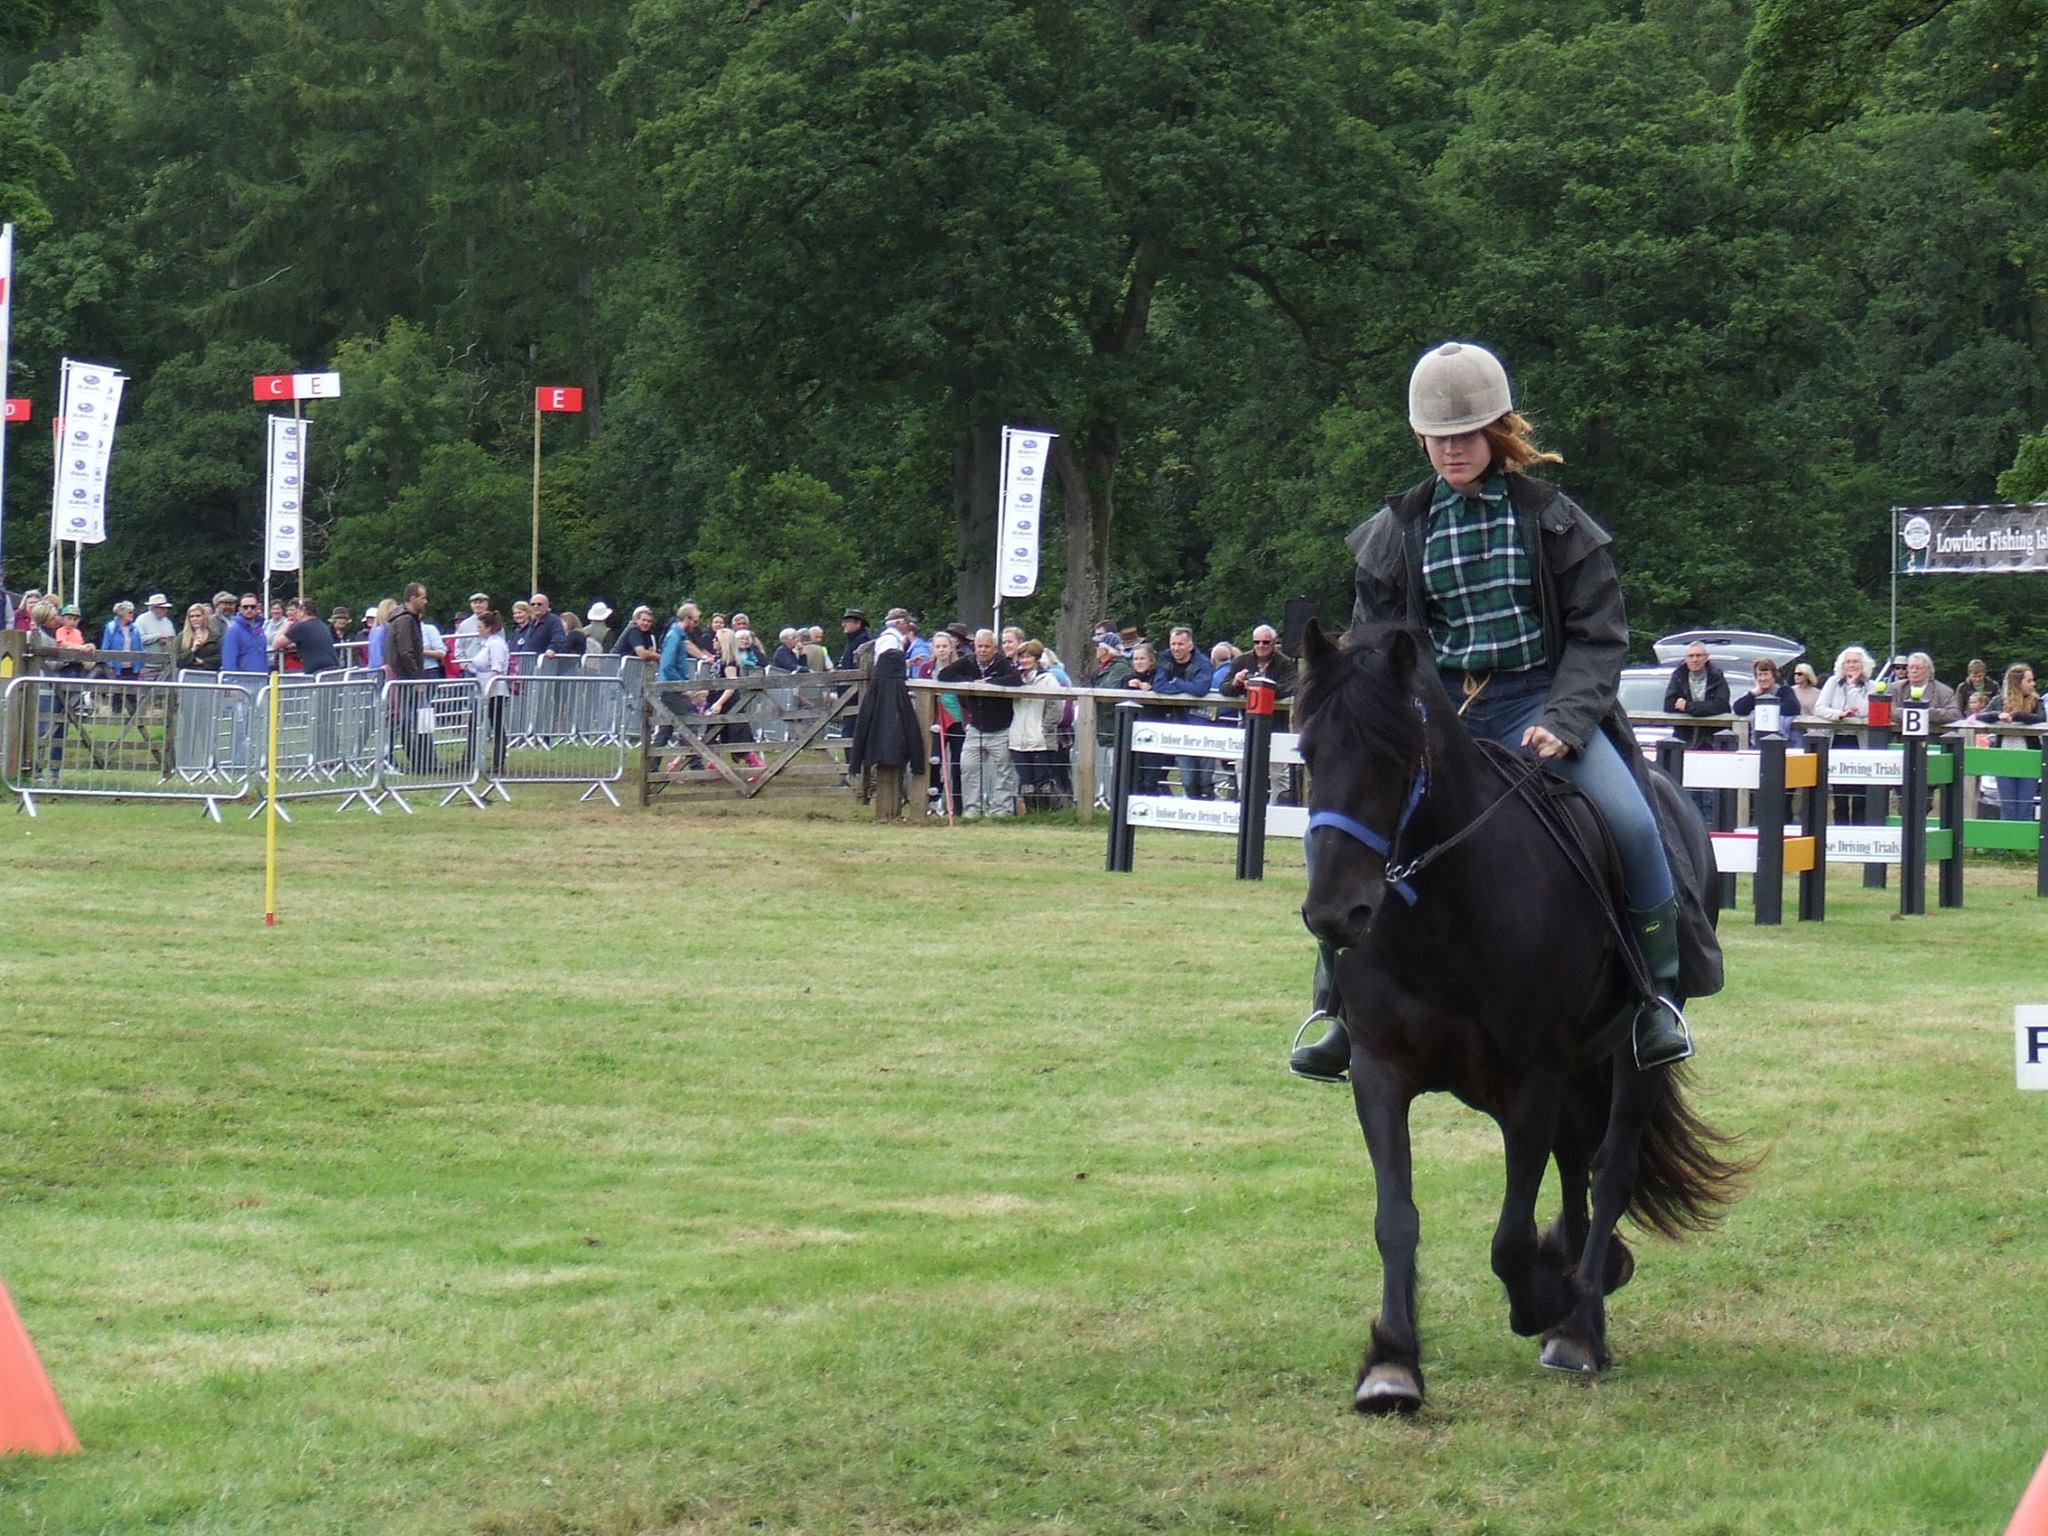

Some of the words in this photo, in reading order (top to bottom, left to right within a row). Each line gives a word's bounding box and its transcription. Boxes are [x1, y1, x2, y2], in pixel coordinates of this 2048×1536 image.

[270, 379, 282, 395] C
[311, 377, 322, 394] E
[553, 390, 565, 408] E
[1936, 528, 1987, 553] Lowther
[1989, 527, 2034, 556] Fishing
[1906, 710, 1921, 732] B
[1839, 762, 1872, 777] Driving
[1874, 762, 1901, 775] Trials
[1838, 840, 1871, 854] Driving
[1874, 841, 1900, 853] Trials
